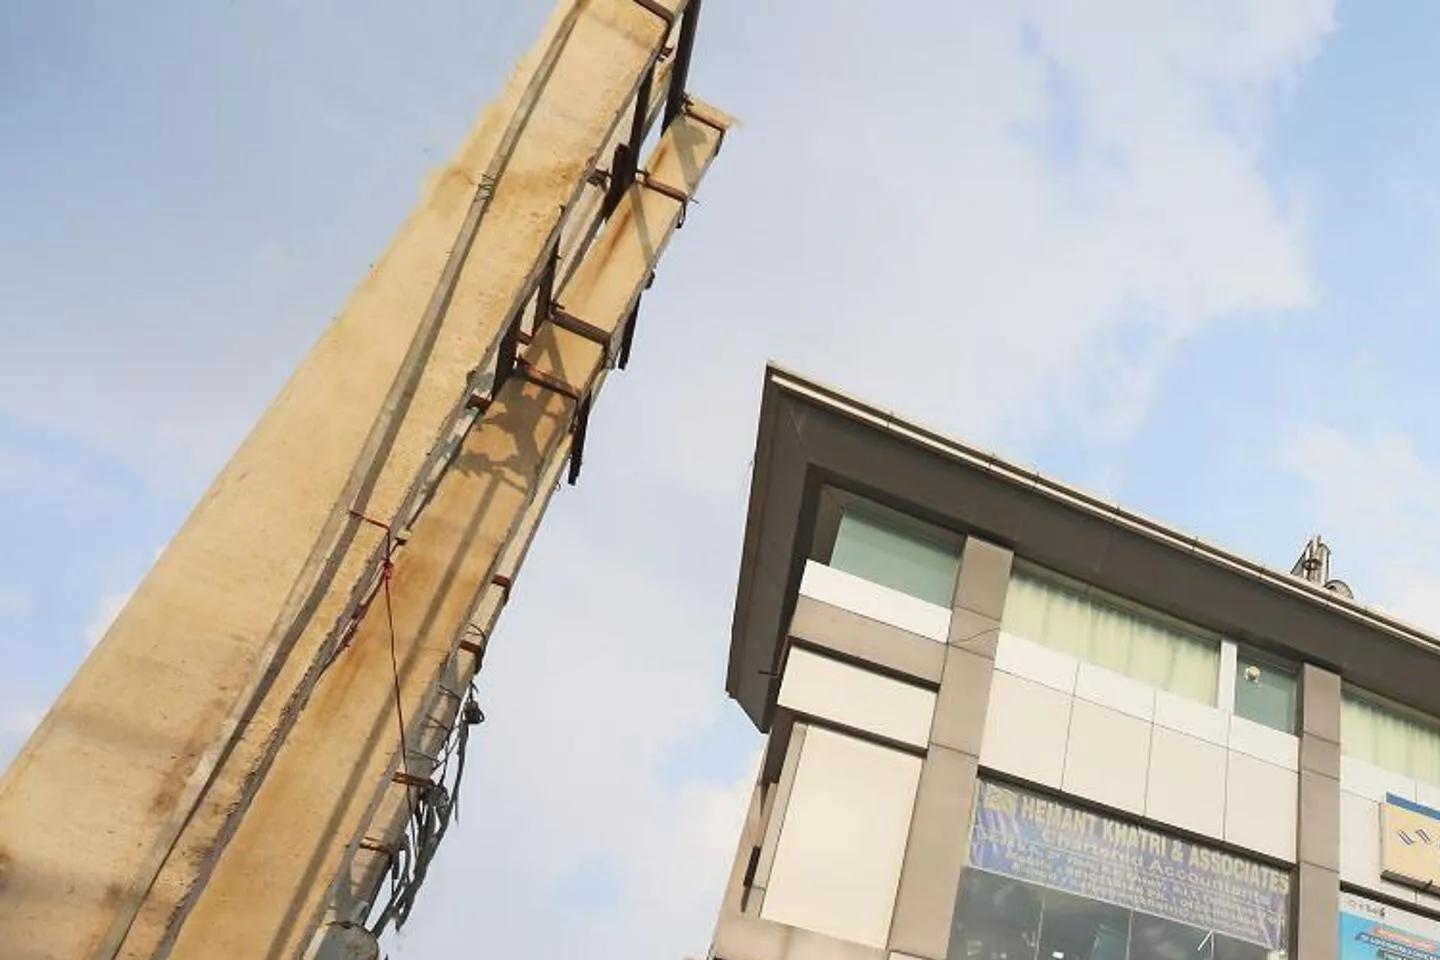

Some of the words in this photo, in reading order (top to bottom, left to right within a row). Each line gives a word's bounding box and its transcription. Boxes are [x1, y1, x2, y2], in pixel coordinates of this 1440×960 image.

[1021, 796, 1095, 838] HEMANT
[1103, 817, 1166, 857] KHATRI
[1170, 840, 1183, 862] &
[1188, 845, 1289, 894] ASSOCIATES
